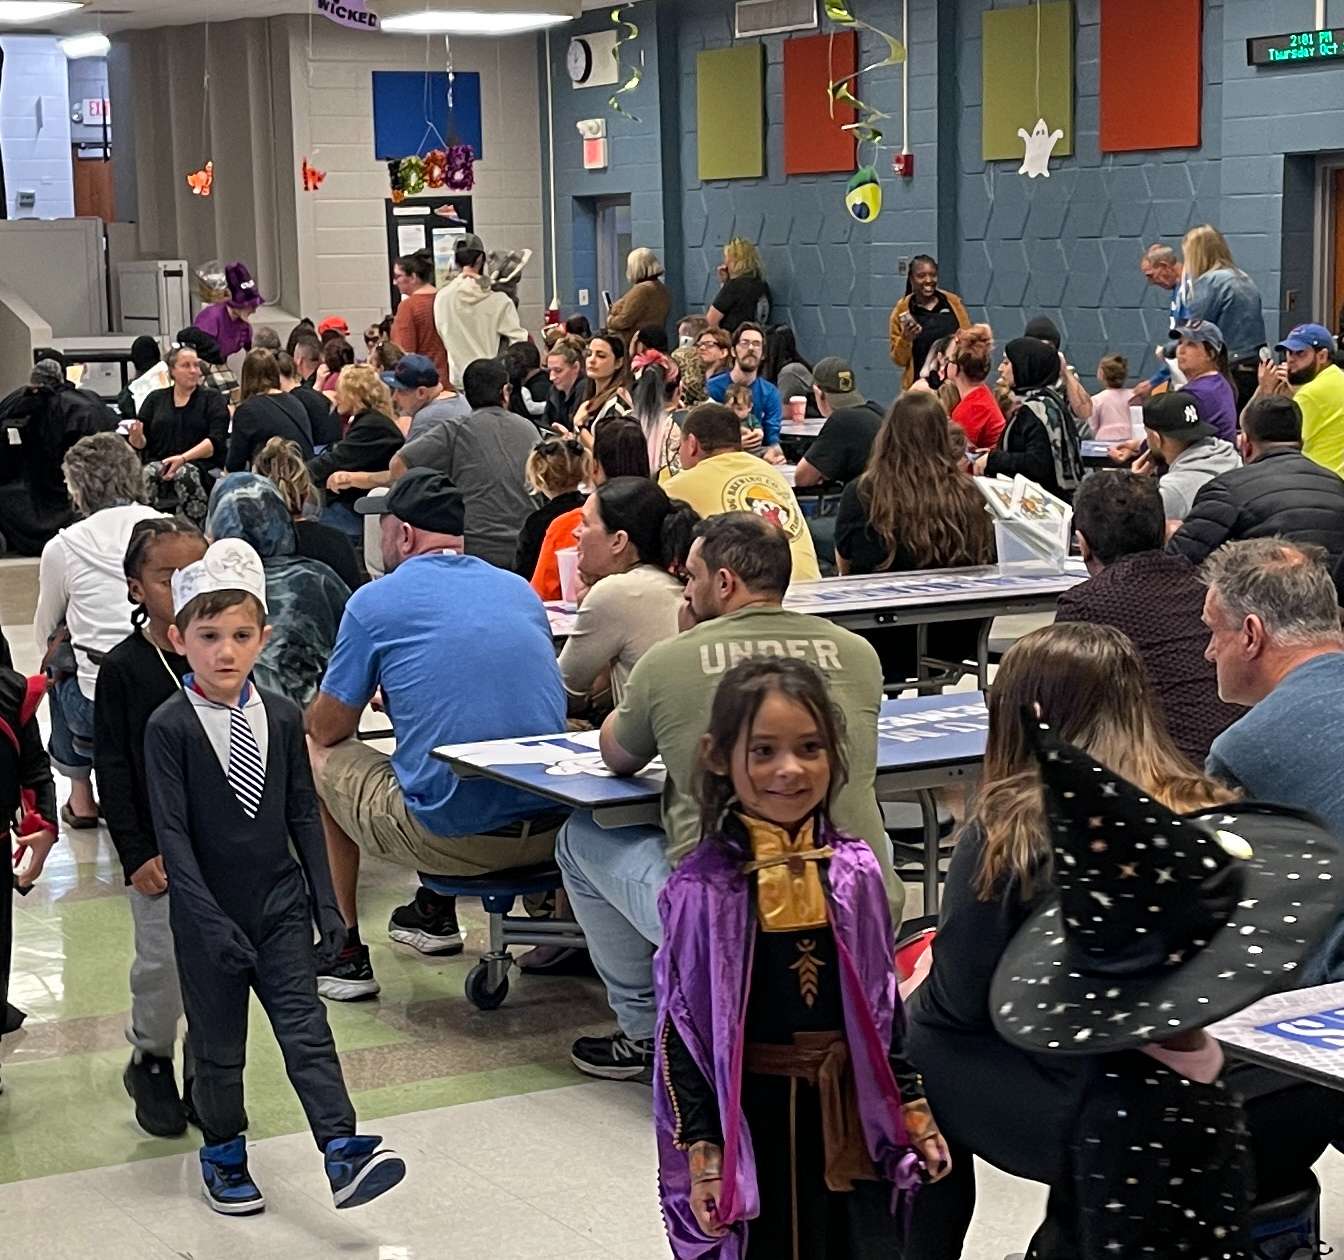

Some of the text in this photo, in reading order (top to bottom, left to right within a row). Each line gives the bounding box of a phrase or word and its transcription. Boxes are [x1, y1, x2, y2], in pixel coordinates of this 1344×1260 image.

[317, 0, 378, 27] WICKED
[1290, 31, 1333, 47] 2:01 PM
[1268, 47, 1316, 60] Thursday
[1319, 43, 1338, 55] Oct
